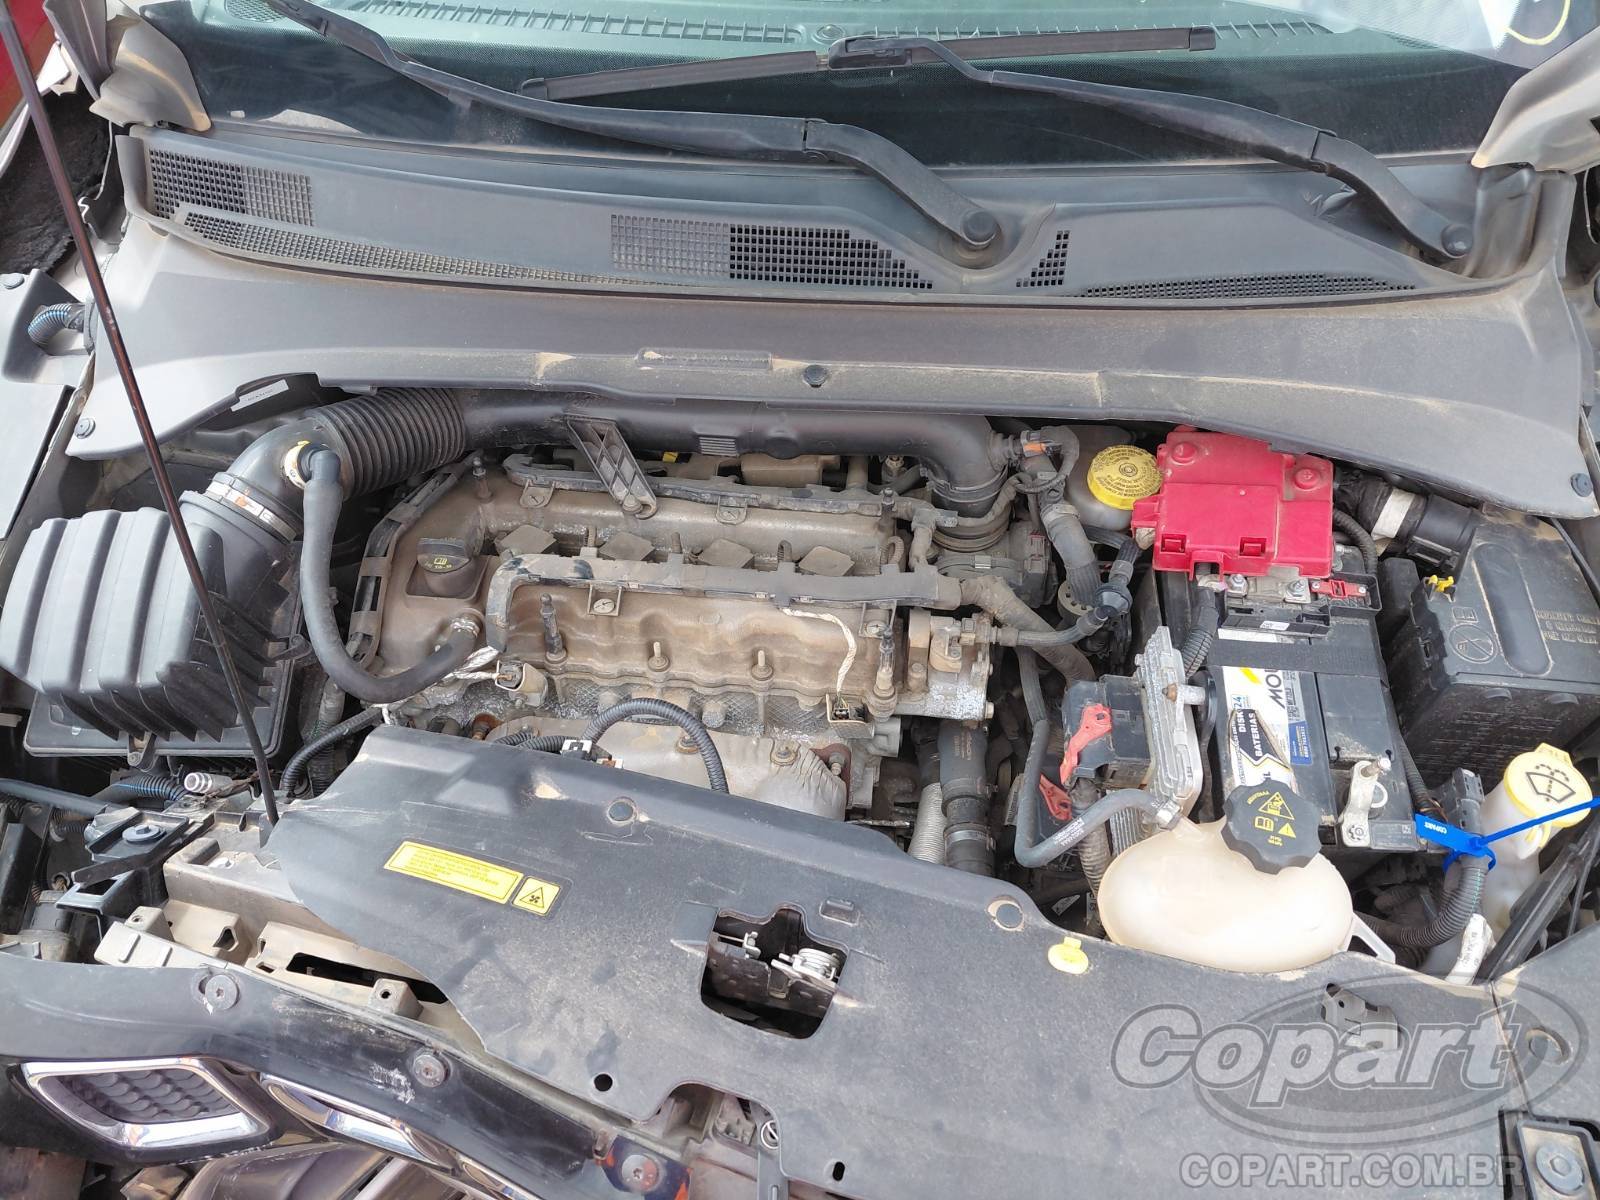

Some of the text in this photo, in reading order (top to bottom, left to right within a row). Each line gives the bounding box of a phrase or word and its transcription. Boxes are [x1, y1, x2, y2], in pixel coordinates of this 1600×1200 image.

[1264, 669, 1286, 709] MO
[1237, 710, 1247, 733] DISK
[1248, 712, 1263, 757] BATERIAS
